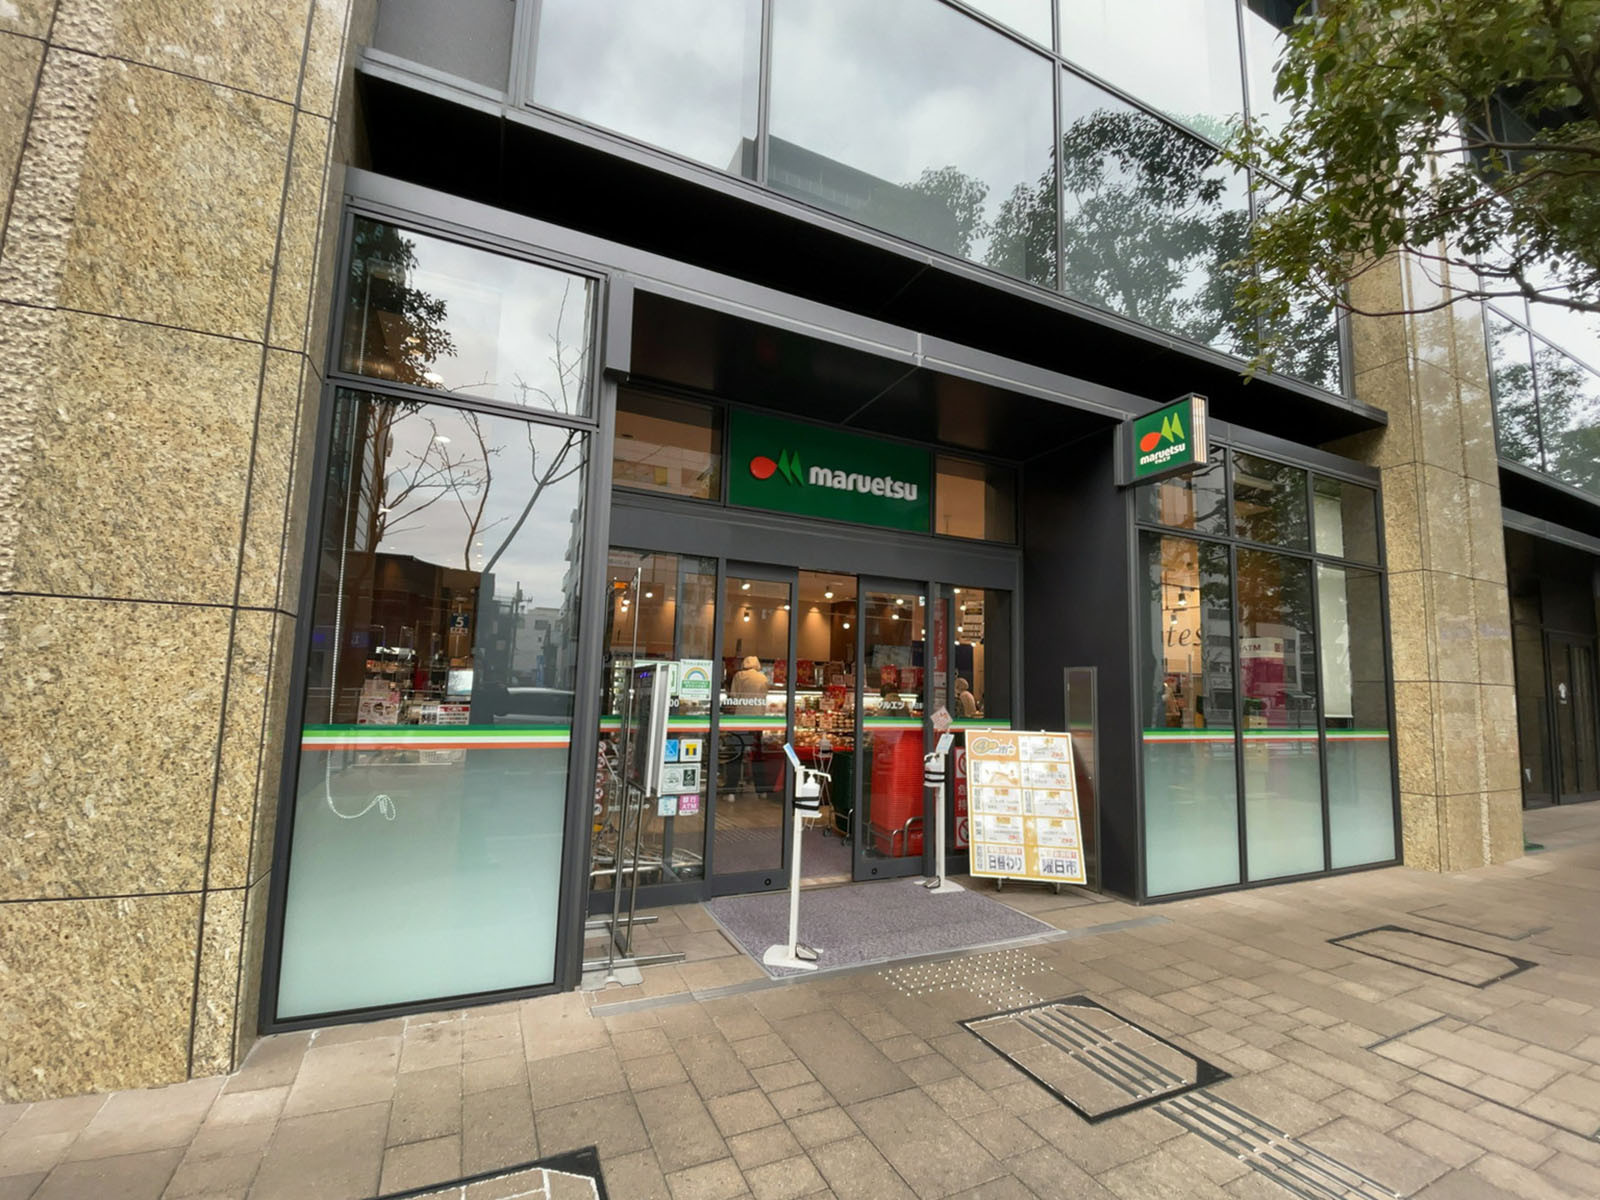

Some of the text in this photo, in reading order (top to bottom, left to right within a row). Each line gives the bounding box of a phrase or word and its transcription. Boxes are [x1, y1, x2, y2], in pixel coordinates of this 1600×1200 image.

[1139, 443, 1186, 465] maruetsu
[808, 464, 918, 502] maruetsu
[455, 616, 464, 628] 5
[723, 697, 766, 706] maruetsu
[685, 743, 698, 756] T
